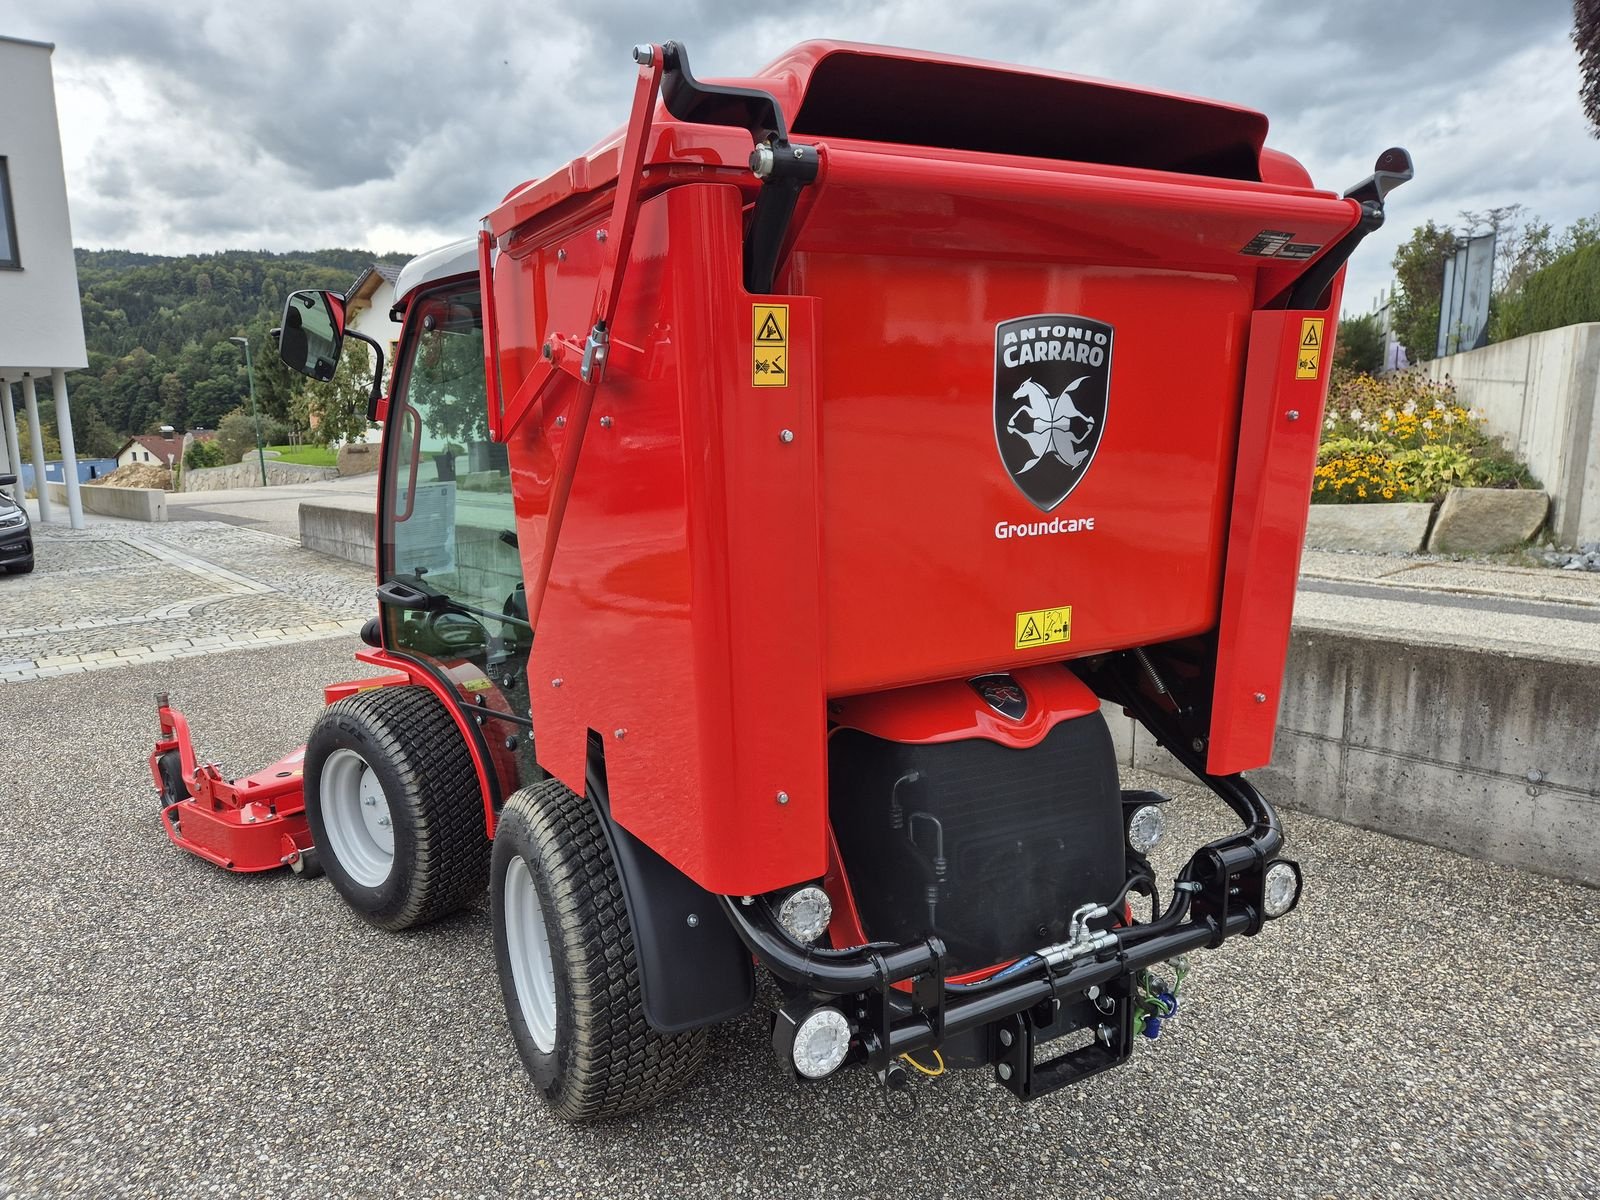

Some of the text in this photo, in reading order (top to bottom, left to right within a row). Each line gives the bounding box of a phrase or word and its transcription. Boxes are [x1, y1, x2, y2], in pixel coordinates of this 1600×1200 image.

[1003, 325, 1107, 346] ANTONIO
[1003, 341, 1104, 368] CARRARO
[995, 518, 1095, 539] Groundcare
